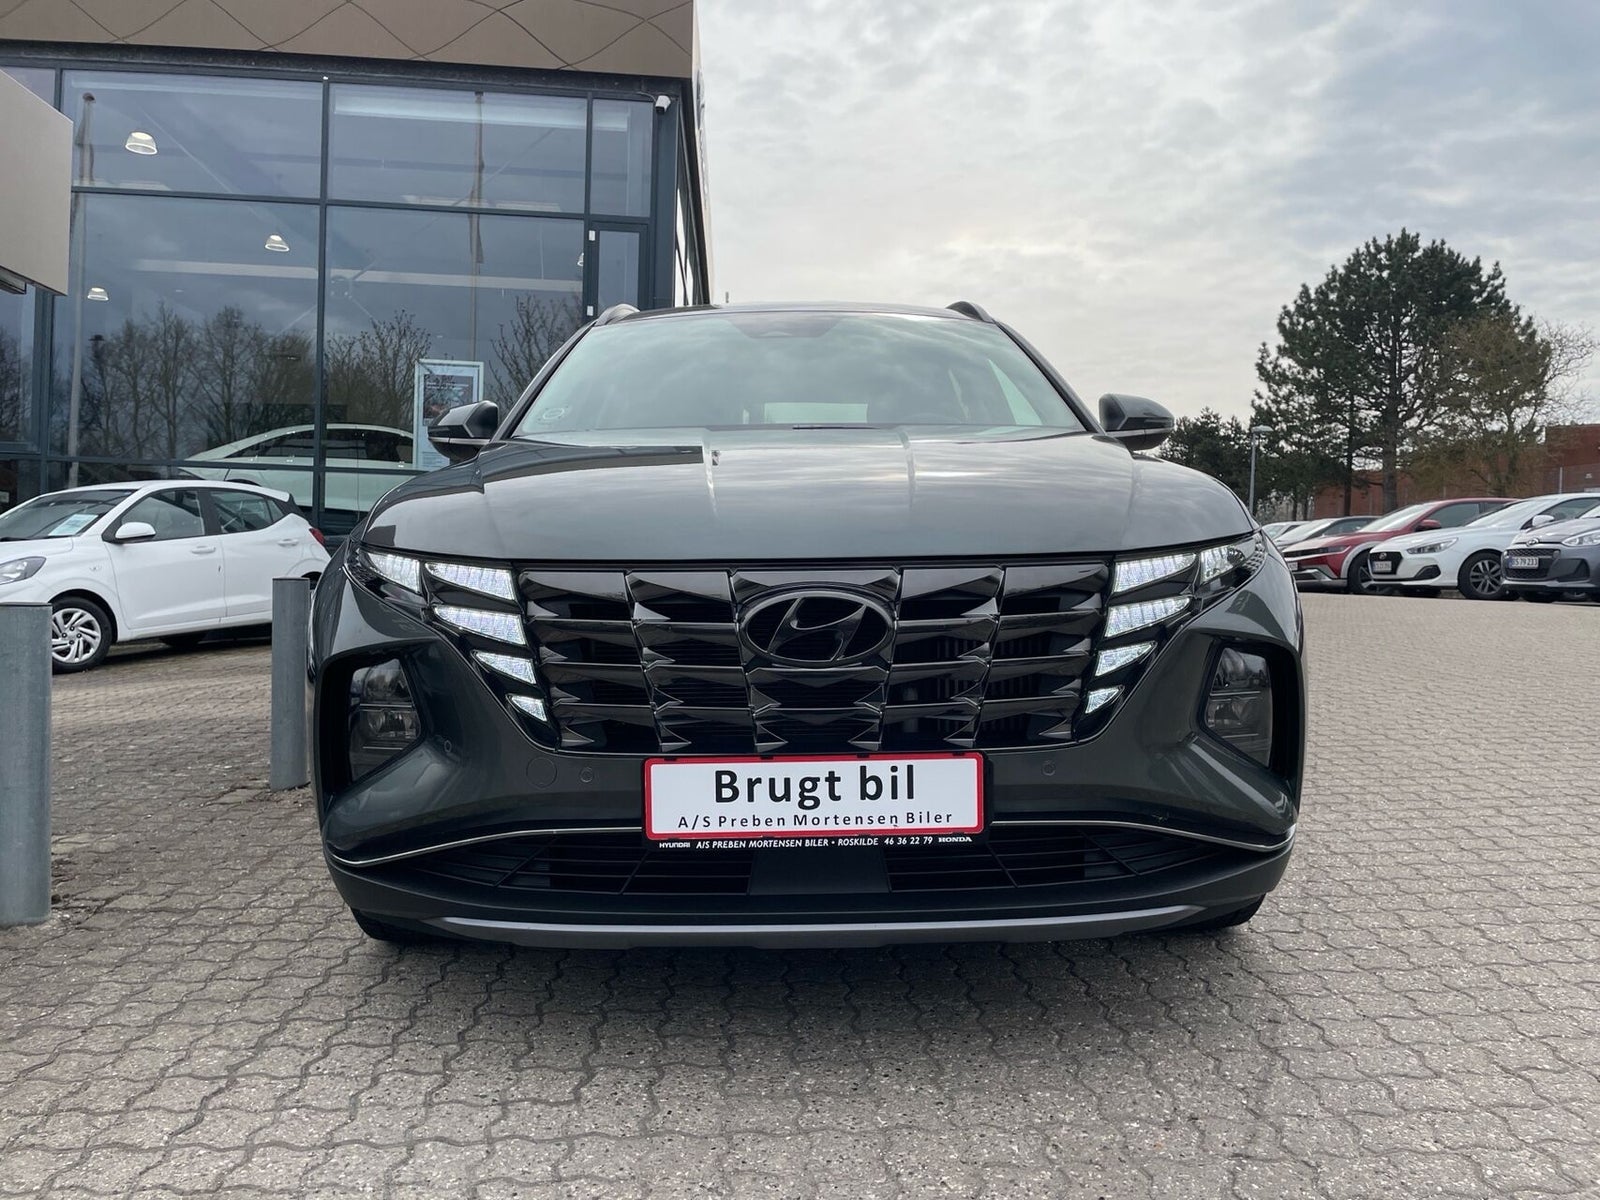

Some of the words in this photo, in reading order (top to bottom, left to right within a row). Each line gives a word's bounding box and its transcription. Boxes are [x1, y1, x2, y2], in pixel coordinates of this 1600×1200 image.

[715, 770, 841, 810] Brugt
[860, 764, 914, 800] bil
[678, 815, 711, 830] A/S
[718, 814, 785, 828] Preben
[793, 814, 898, 826] Mortensen
[906, 811, 952, 824] Biler
[712, 840, 746, 849] PREBEN
[749, 839, 802, 848] MORTENSEN
[805, 838, 829, 847] BILER
[838, 837, 879, 846] ROSKILDE
[884, 837, 895, 845] 46
[897, 837, 907, 845] 36
[910, 836, 920, 845] 22
[923, 836, 934, 844] 79
